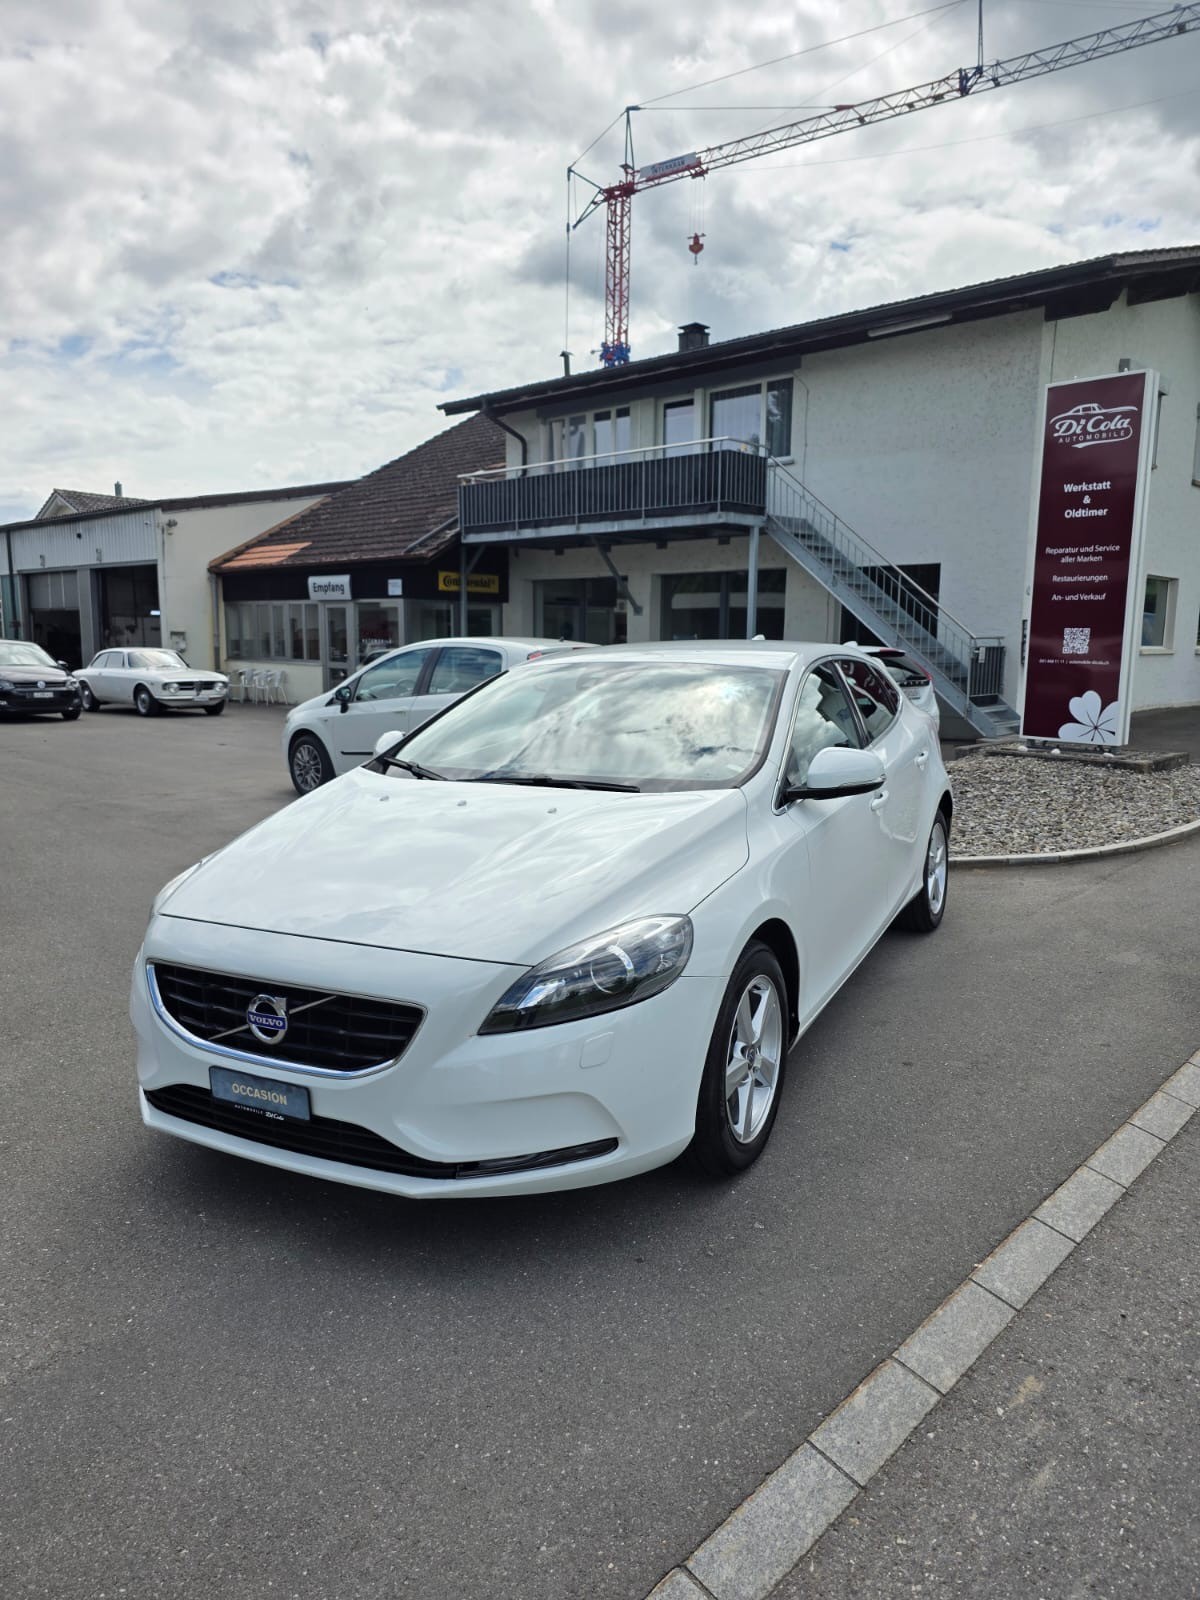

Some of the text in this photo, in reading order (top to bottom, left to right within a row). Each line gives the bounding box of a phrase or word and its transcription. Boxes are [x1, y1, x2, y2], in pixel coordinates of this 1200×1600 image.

[1053, 415, 1131, 437] Di Cola
[1058, 430, 1125, 443] AUTOMOBILE
[1063, 481, 1111, 493] Werkstatt
[1082, 495, 1091, 504] &
[1064, 508, 1109, 518] Oldtimer
[1045, 544, 1120, 555] Reparatur und Service
[1076, 555, 1103, 563] Marken
[1052, 574, 1108, 583] Restaurierungen
[313, 581, 345, 596] Empfang
[1051, 593, 1064, 601] An-
[1079, 592, 1106, 600] Verkauf
[249, 1014, 284, 1027] VOLVO
[231, 1083, 288, 1105] OCCASION
